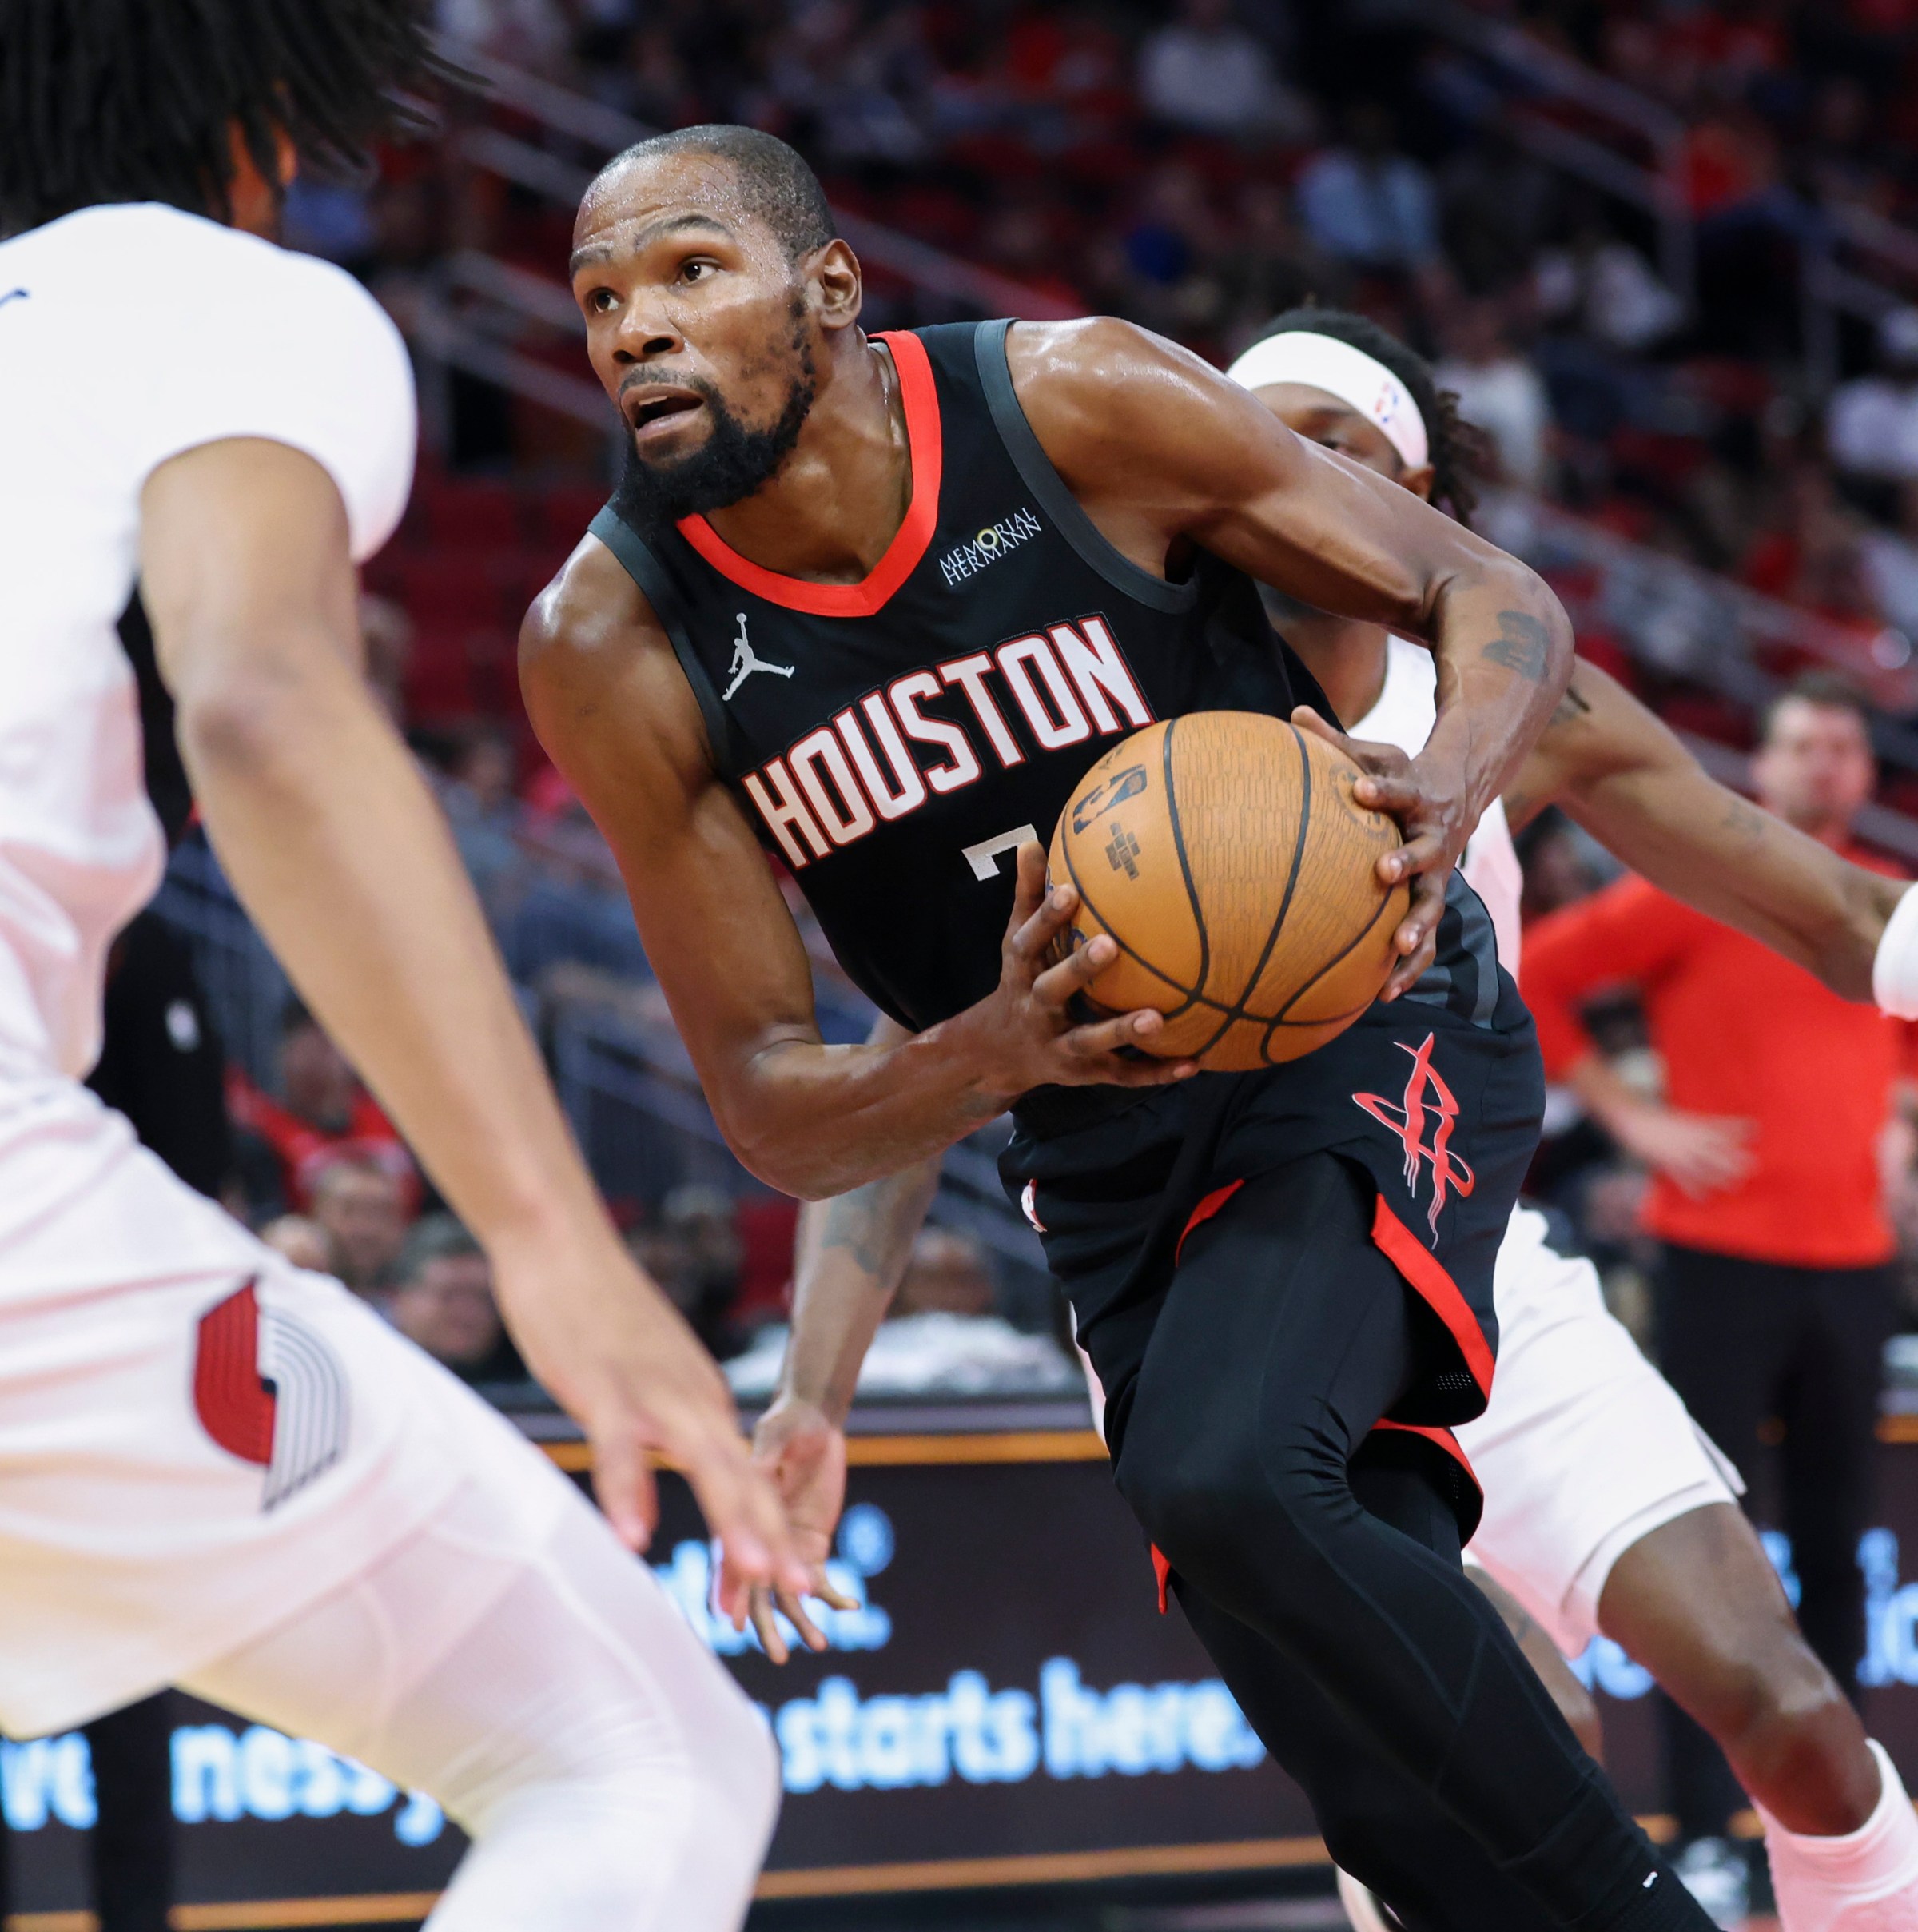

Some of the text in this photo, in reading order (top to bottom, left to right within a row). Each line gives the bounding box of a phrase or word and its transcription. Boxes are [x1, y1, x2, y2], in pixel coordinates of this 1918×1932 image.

[939, 507, 1037, 574] MEMORIAL
[944, 516, 1041, 586] HERMANN
[742, 616, 1155, 870] HOUSTON
[776, 1674, 1038, 1795] starts
